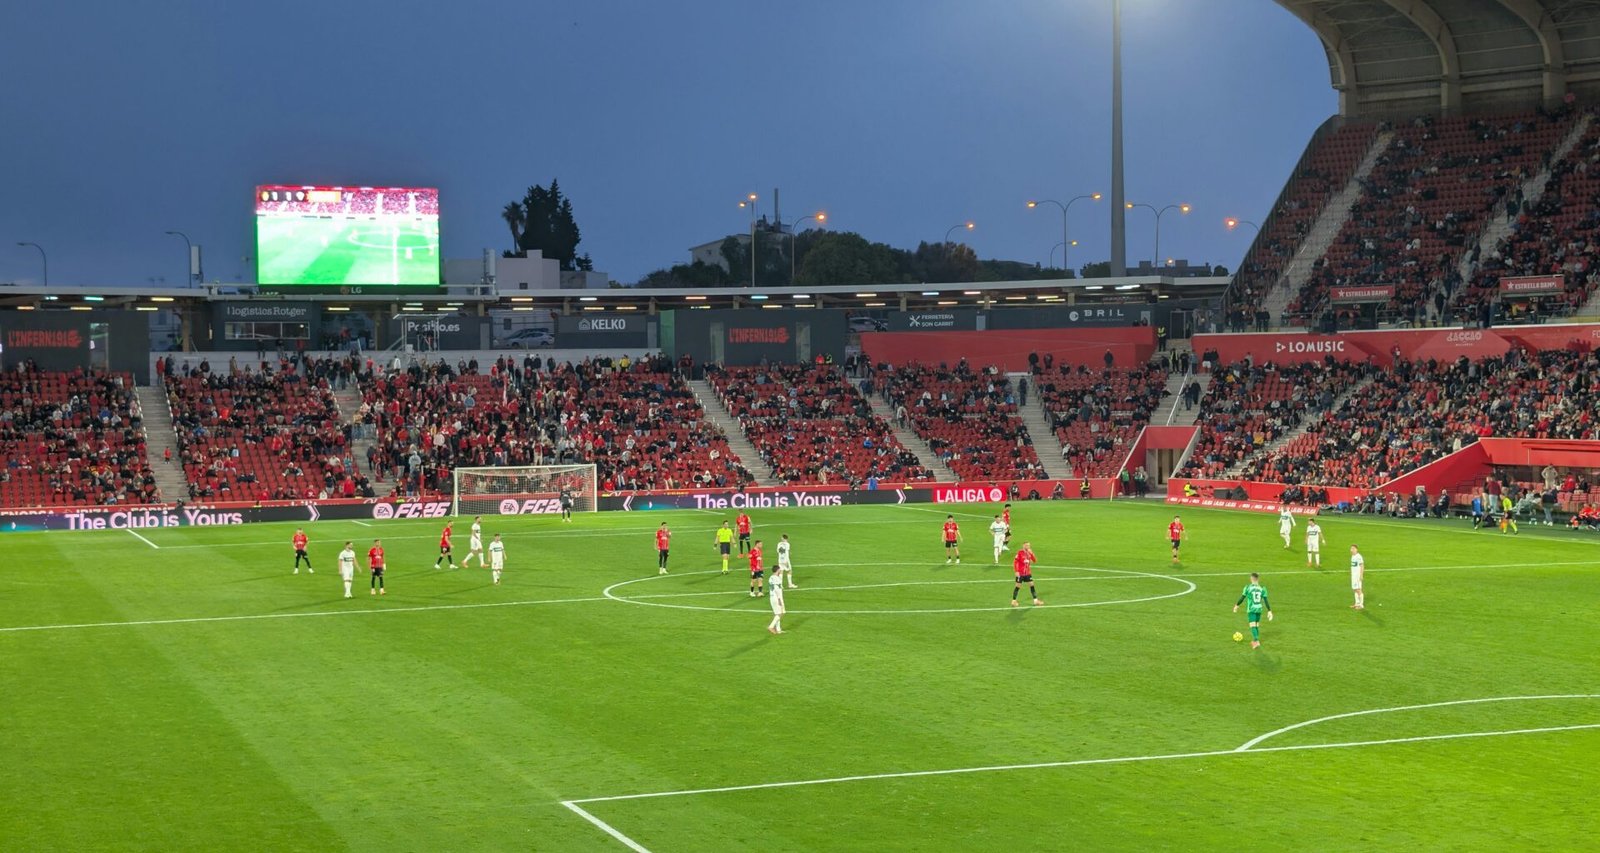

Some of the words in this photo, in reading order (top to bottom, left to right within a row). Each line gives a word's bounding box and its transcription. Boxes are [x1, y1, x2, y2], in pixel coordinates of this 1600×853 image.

[591, 319, 626, 330] KELKO
[1289, 341, 1344, 353] LOMUSIC
[693, 494, 728, 509] The
[731, 492, 772, 509] Club
[774, 491, 789, 507] is
[792, 491, 842, 507] Yours
[936, 488, 986, 503] LALIGA
[64, 513, 106, 530] The
[110, 512, 159, 528] Club
[162, 510, 180, 527] is
[184, 509, 243, 526] Yours
[1252, 591, 1261, 603] 13
